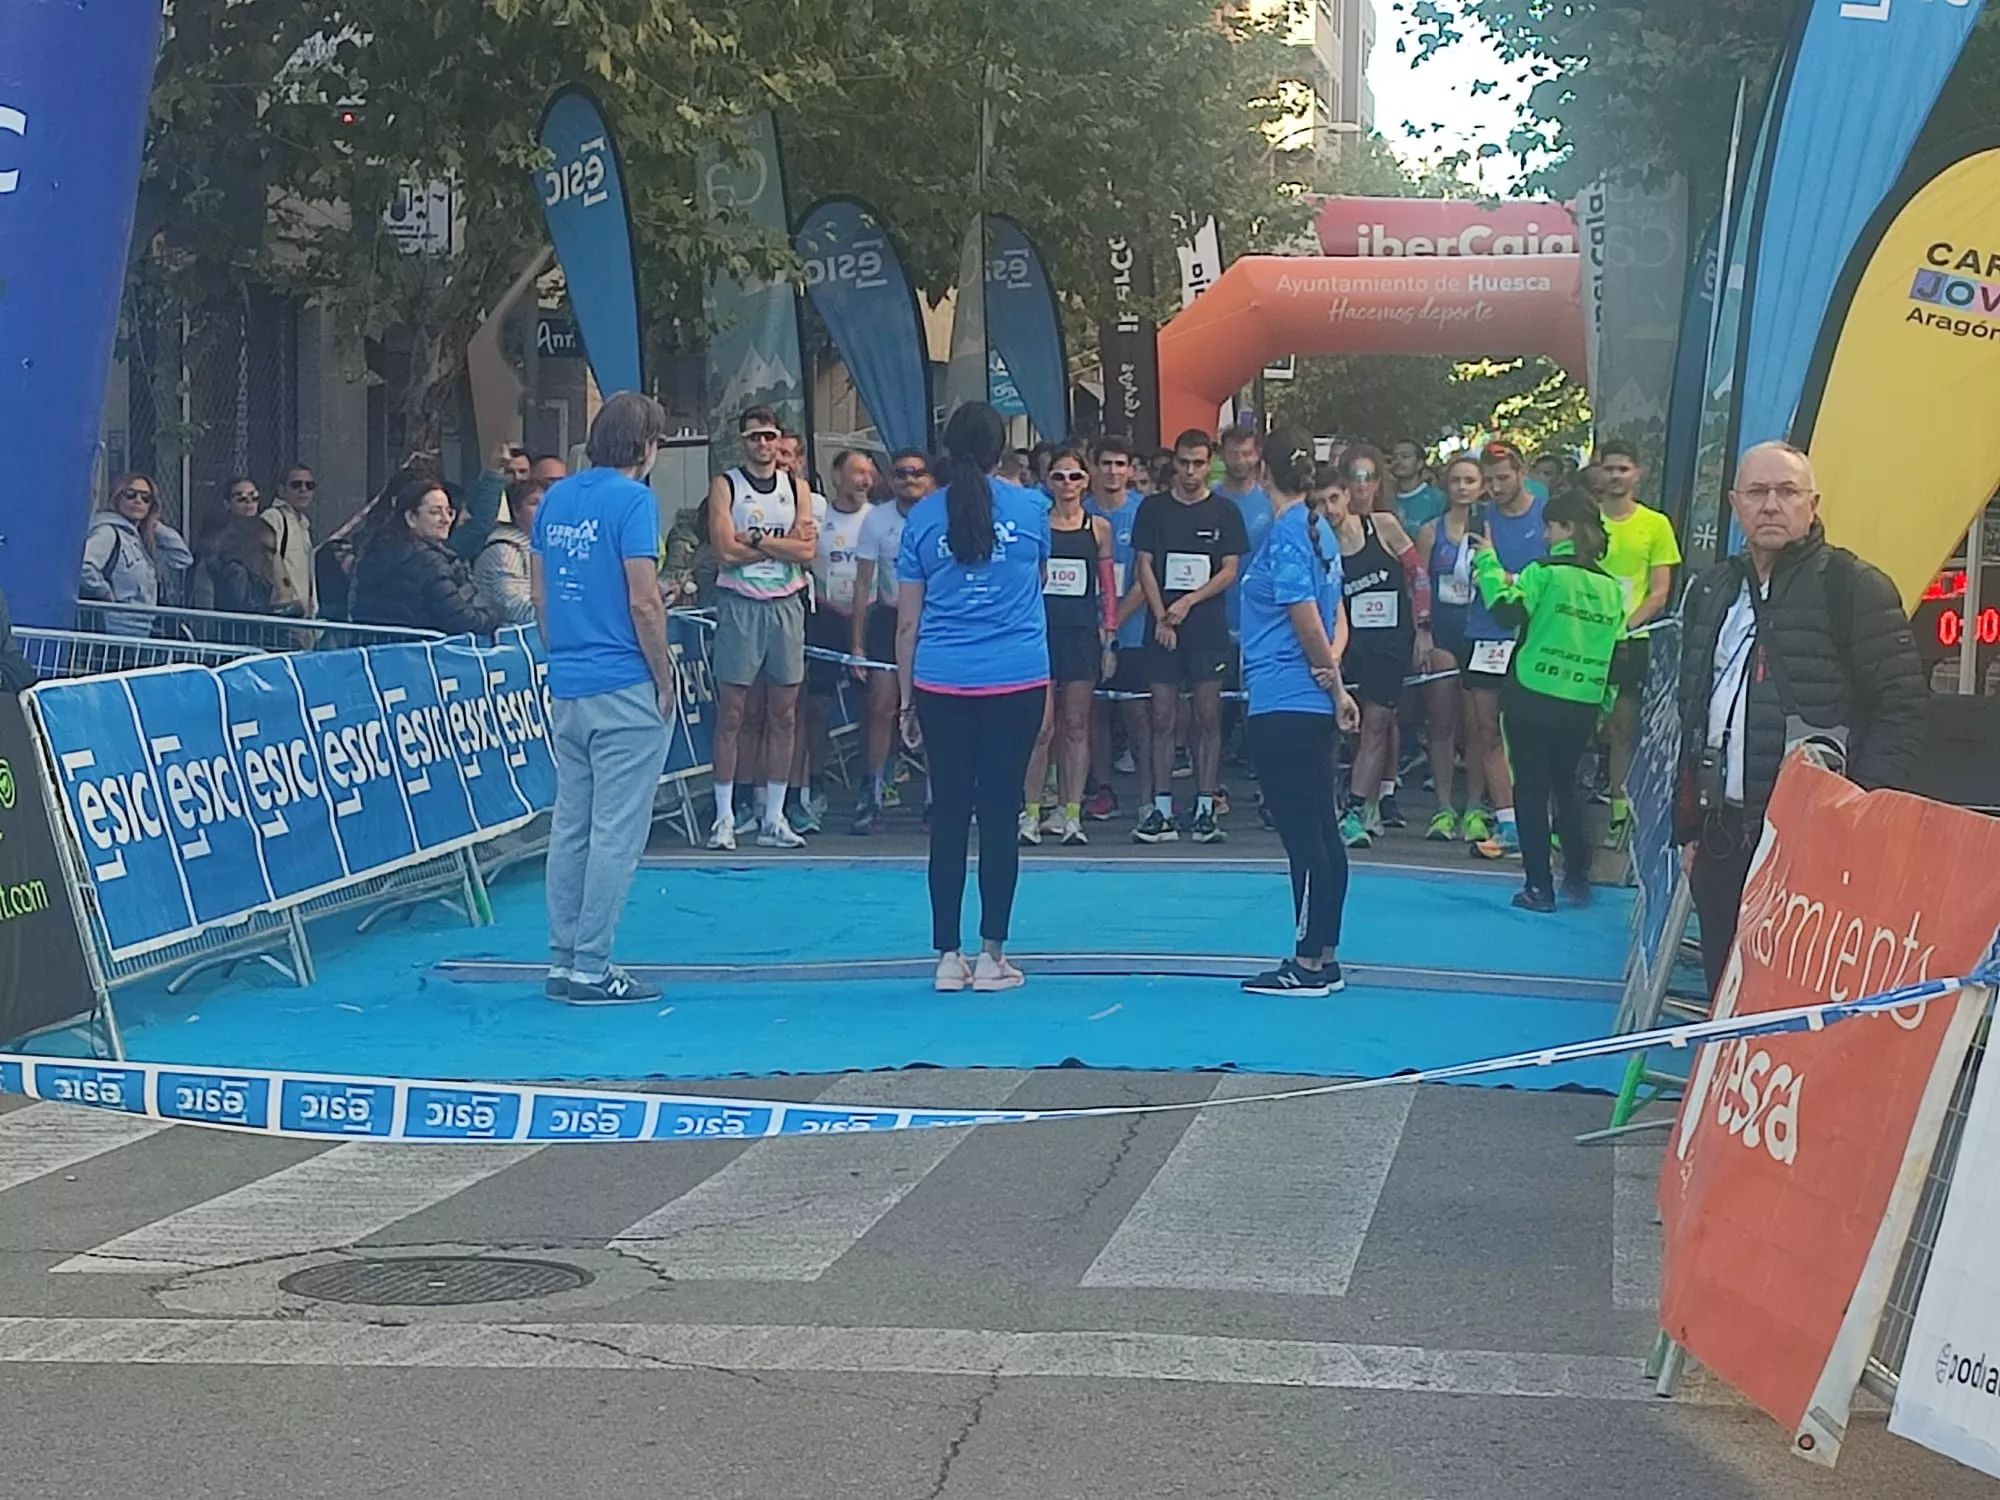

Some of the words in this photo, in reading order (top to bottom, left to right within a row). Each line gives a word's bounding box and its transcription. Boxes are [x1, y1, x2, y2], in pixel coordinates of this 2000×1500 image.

[1276, 273, 1428, 296] Ayuntamiento
[1433, 274, 1461, 292] de
[1467, 273, 1551, 291] Huesca
[1328, 296, 1417, 325] Hacemos
[1417, 295, 1497, 332] deporte
[1051, 570, 1077, 582] 100
[1183, 565, 1192, 576] 3
[1365, 601, 1383, 613] 20
[1487, 648, 1505, 660] 24
[496, 687, 543, 744] esic
[395, 706, 451, 768] esic
[323, 720, 391, 788] esic
[245, 739, 319, 811] esic
[166, 756, 242, 830] esic
[78, 771, 162, 850] esic
[176, 1087, 245, 1114] esic
[300, 1095, 370, 1122] esic
[425, 1103, 495, 1129] esic
[550, 1110, 621, 1134] esic
